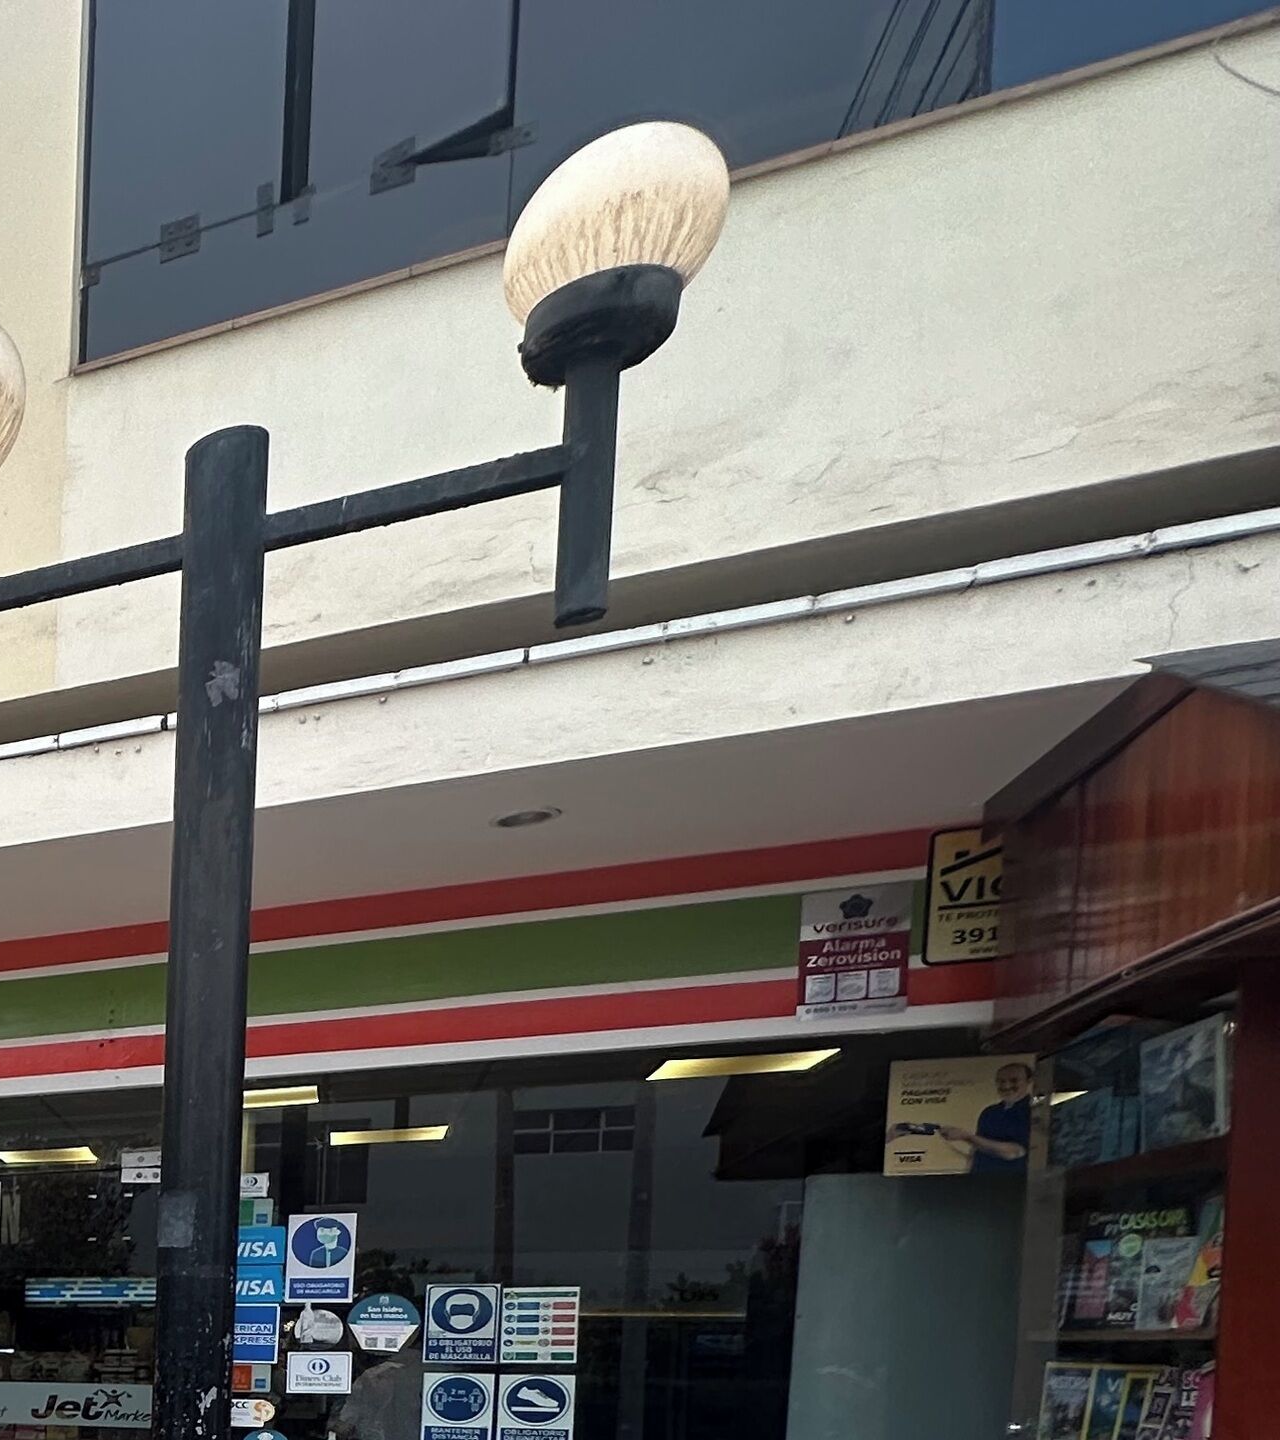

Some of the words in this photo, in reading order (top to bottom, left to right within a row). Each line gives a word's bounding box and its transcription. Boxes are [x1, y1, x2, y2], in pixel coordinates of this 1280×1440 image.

[813, 916, 898, 933] verisure
[952, 926, 998, 945] 391
[822, 937, 886, 953] Alarma
[806, 949, 901, 968] Zerovision
[429, 1339, 438, 1347] ES
[439, 1339, 492, 1347] OBLIGATORIO
[322, 1374, 342, 1382] Club
[31, 1394, 104, 1421] Jet
